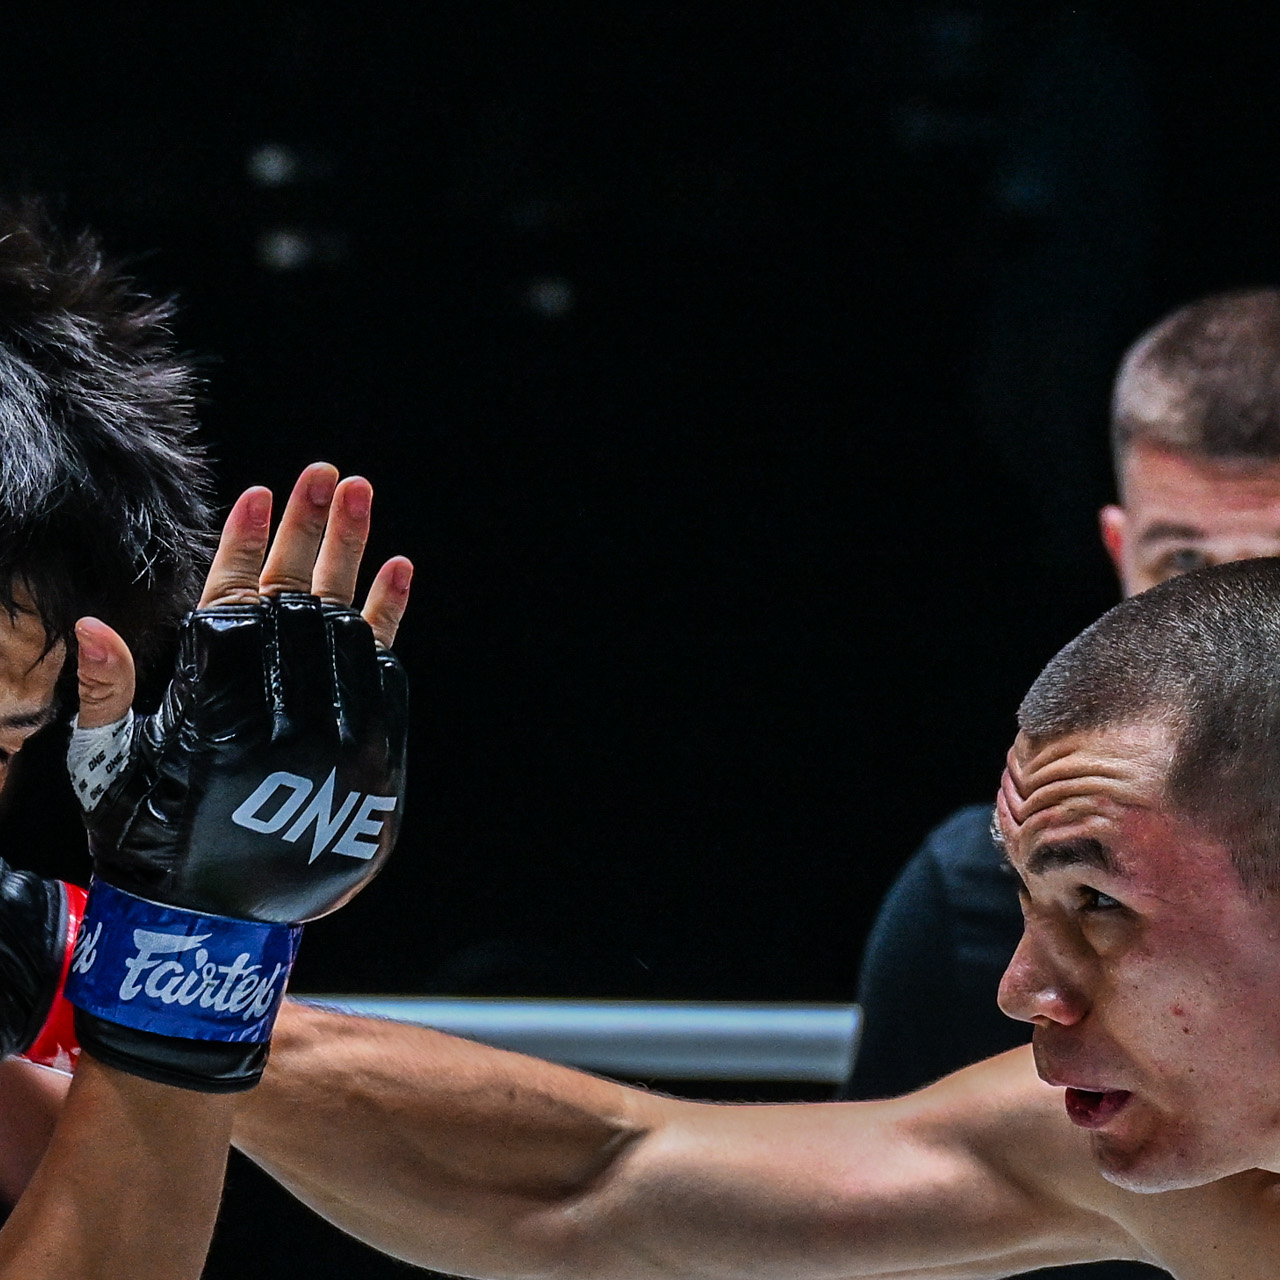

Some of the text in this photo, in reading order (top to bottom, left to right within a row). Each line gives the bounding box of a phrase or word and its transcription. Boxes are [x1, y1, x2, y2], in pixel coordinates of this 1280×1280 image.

[88, 750, 106, 772] ONE
[232, 766, 397, 865] ONE
[119, 929, 281, 1021] Fairtex
